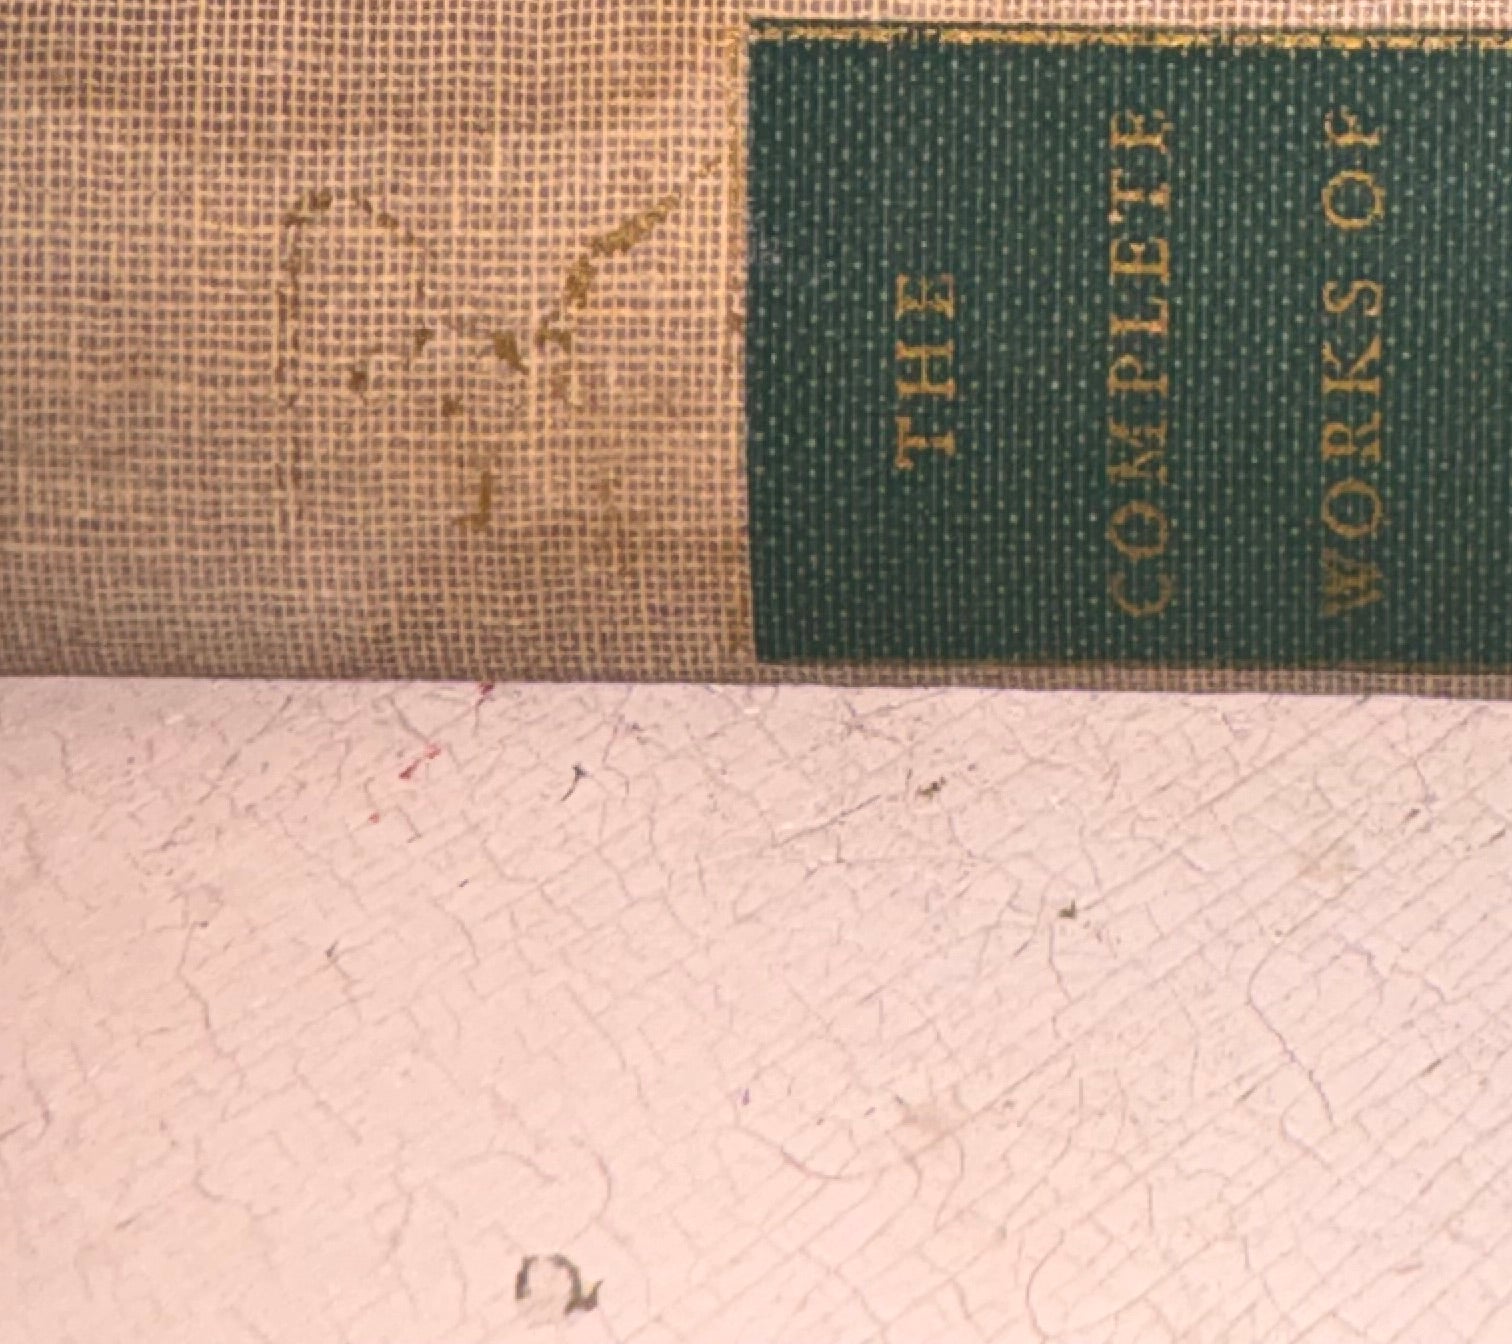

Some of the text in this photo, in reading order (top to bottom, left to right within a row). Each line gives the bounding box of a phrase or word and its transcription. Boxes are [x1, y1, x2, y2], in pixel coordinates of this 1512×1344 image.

[894, 274, 956, 472] THE
[1106, 109, 1172, 618] COMPLETE
[1320, 109, 1388, 618] WORKS OF
